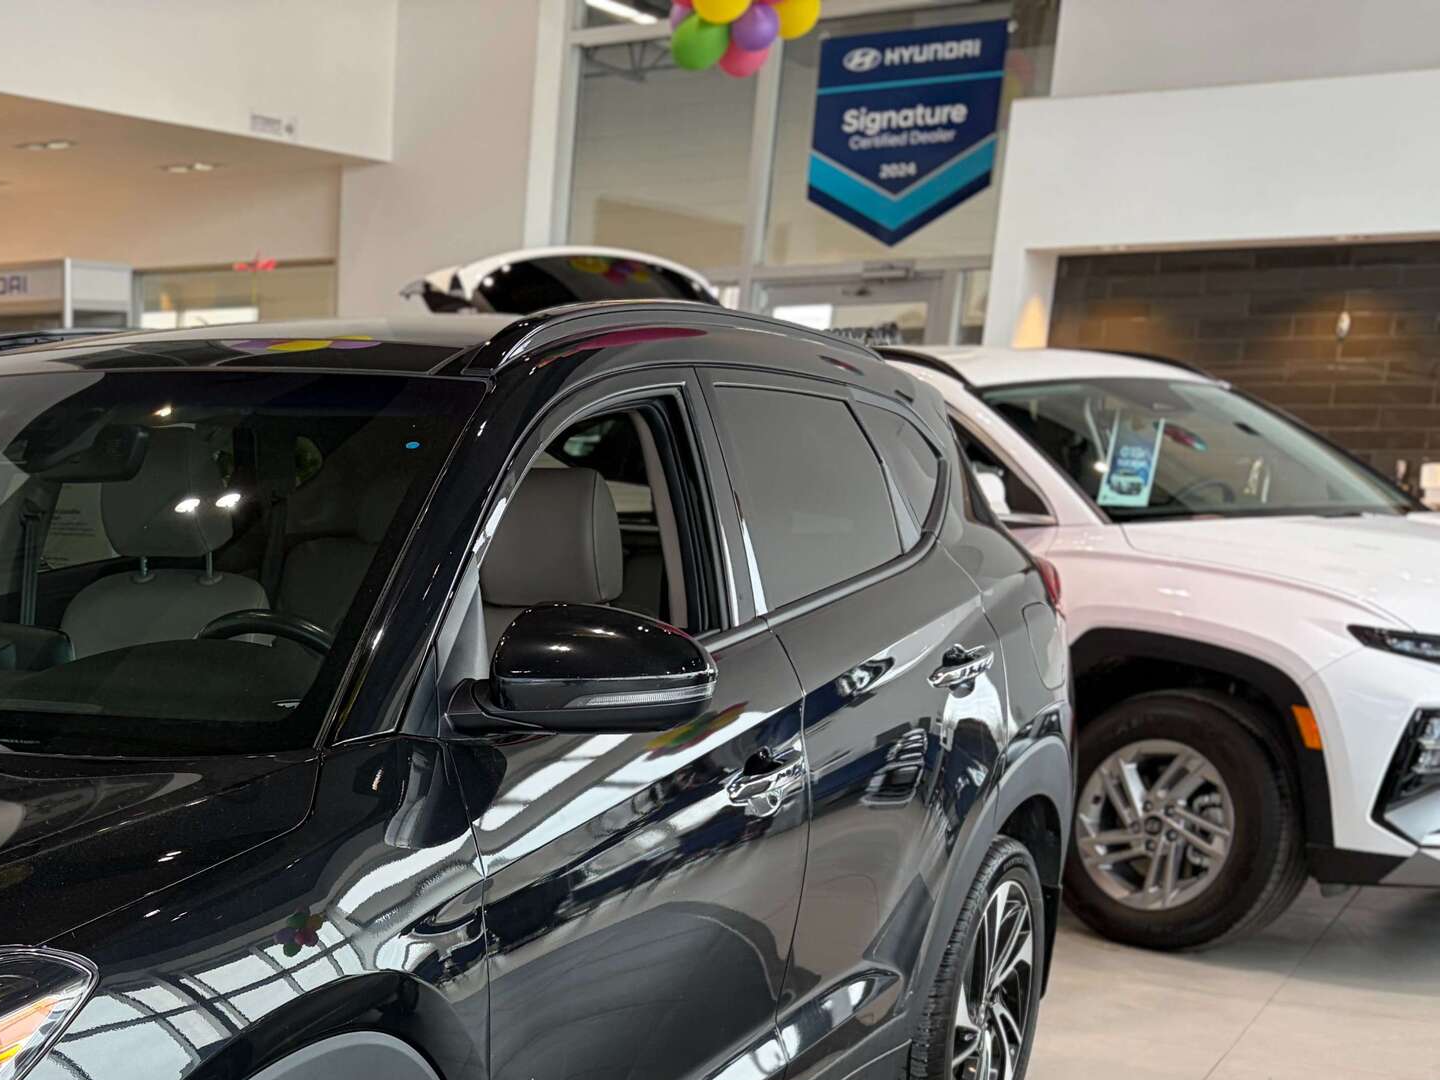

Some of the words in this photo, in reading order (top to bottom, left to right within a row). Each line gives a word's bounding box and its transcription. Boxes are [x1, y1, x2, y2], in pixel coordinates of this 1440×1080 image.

[884, 39, 981, 66] HYUNDAI
[841, 103, 968, 135] Signature
[848, 131, 907, 150] Certified
[910, 128, 956, 146] Dealer
[879, 161, 917, 179] 2024
